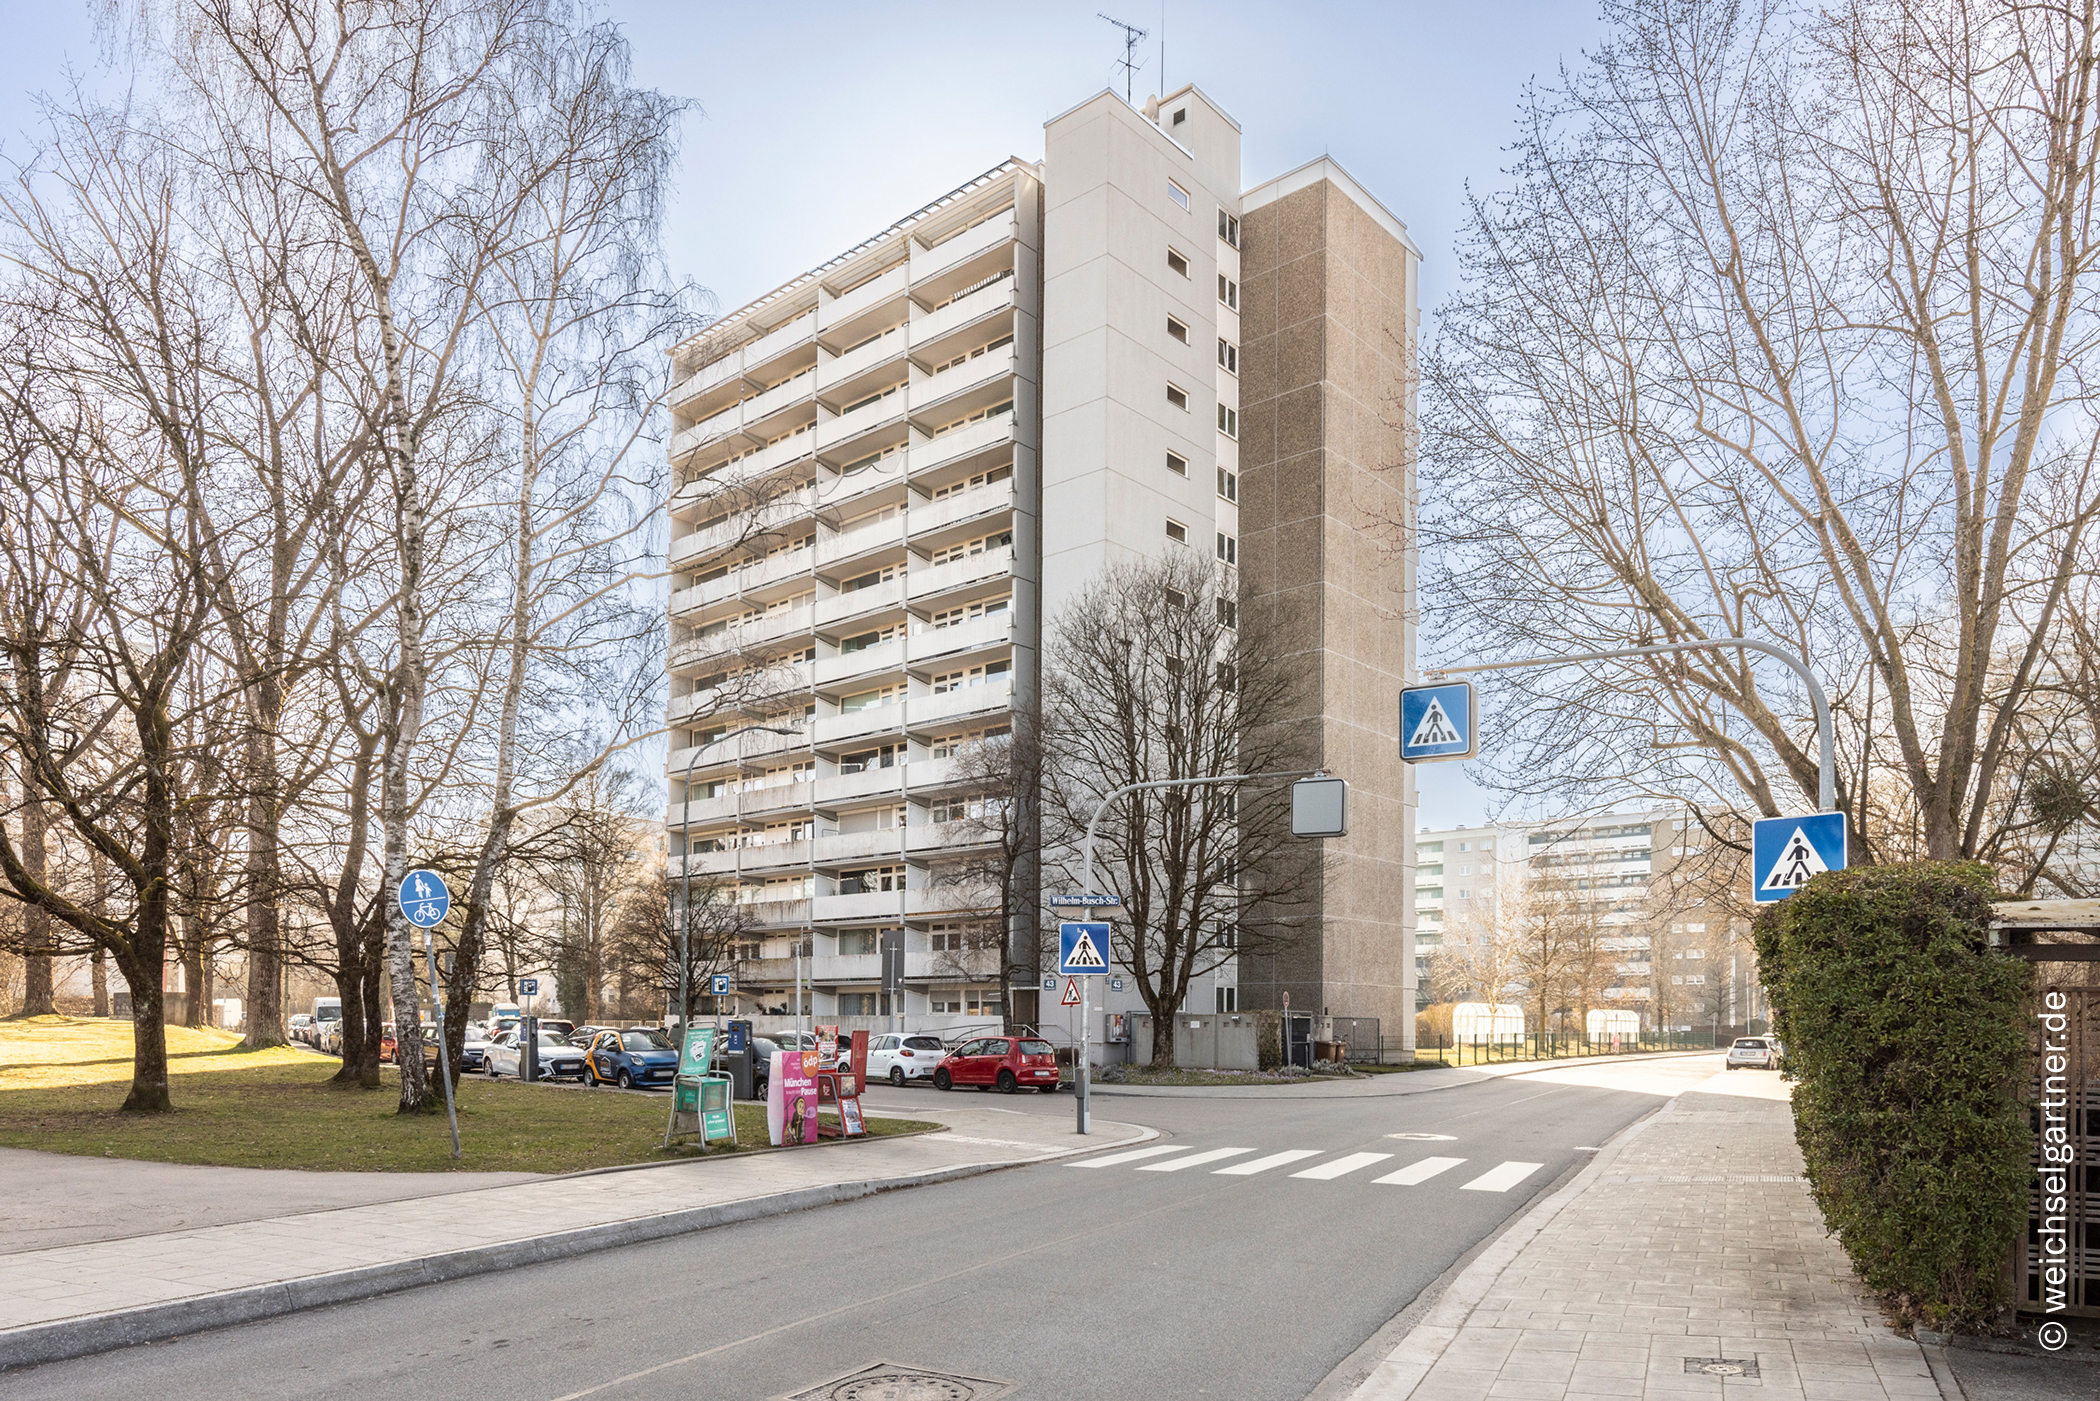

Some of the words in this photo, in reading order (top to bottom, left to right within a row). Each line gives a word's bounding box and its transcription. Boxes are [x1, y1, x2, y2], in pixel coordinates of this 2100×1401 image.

[1052, 896, 1118, 905] Wilhelm-Busch-Str.
[803, 1055, 818, 1068] ödp
[784, 1078, 812, 1088] München
[801, 1087, 817, 1096] Pause
